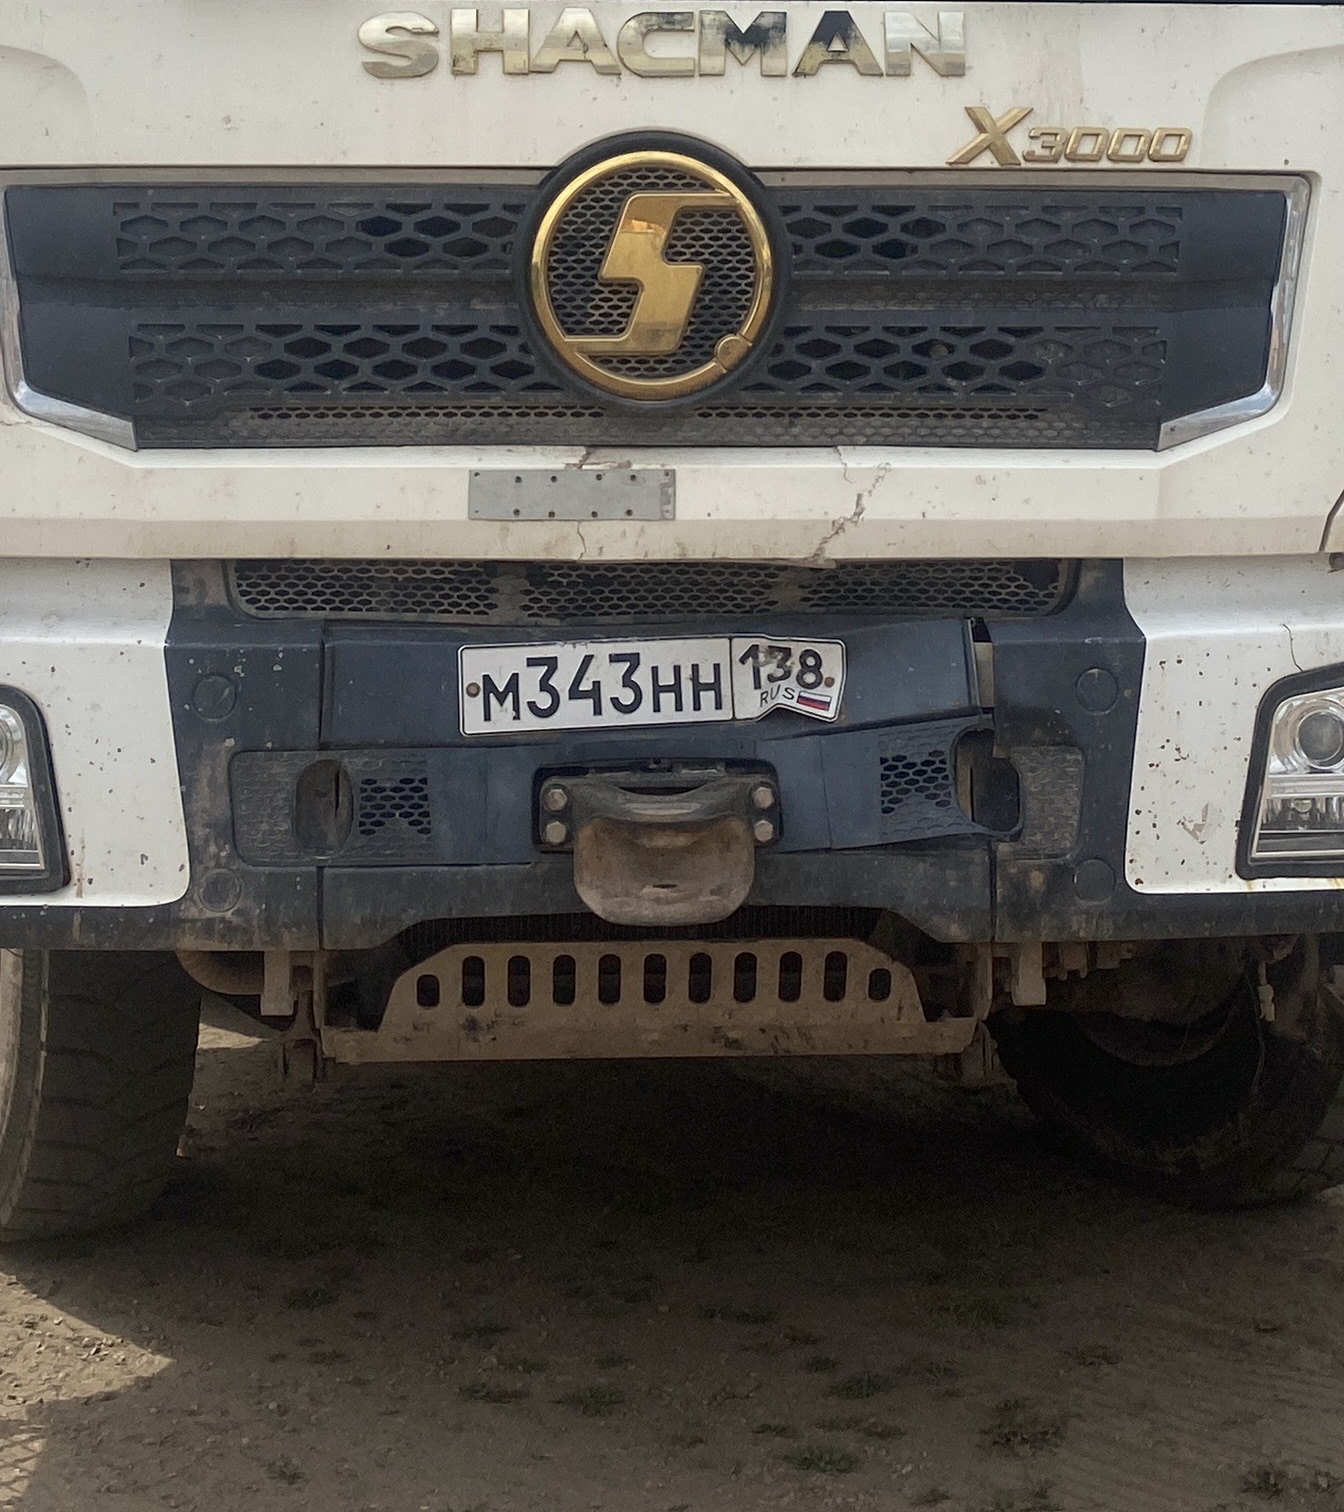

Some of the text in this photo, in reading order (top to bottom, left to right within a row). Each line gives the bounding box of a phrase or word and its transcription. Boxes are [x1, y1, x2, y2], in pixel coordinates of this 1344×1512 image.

[357, 6, 967, 79] SHACMAN
[945, 106, 1193, 166] X3000
[738, 643, 824, 690] 138
[760, 683, 795, 709] RUS
